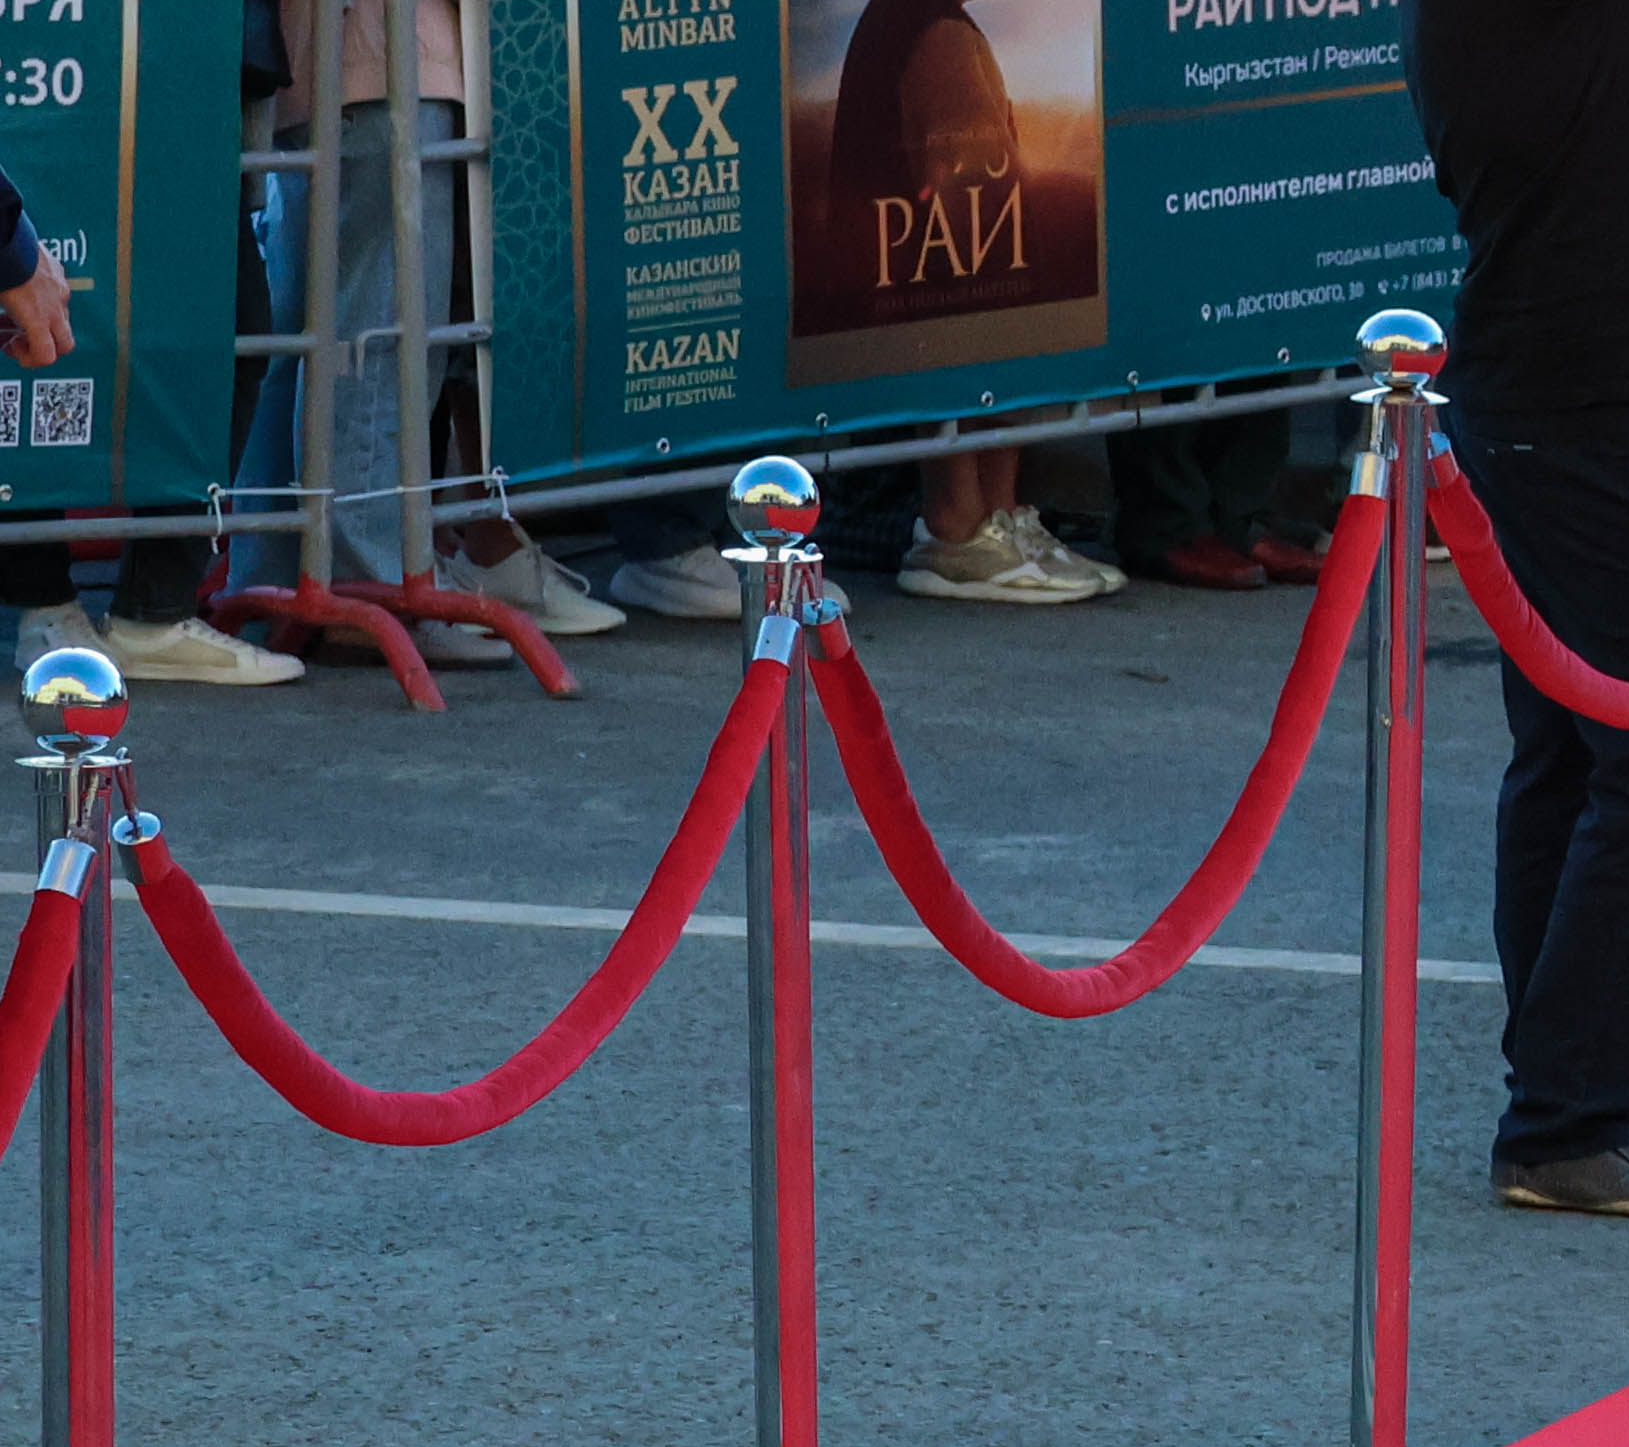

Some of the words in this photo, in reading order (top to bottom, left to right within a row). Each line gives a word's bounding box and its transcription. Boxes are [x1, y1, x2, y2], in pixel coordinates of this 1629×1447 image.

[620, 13, 737, 52] MINBAR
[0, 57, 83, 106] :30
[1184, 54, 1309, 91] Кыргызстан
[623, 159, 740, 205] КАЗАН
[1184, 172, 1343, 212] исполнителем
[1347, 154, 1437, 189] главной
[623, 213, 742, 244] ФЕСТИВАЛЕ
[872, 152, 1030, 289] РАЙ
[626, 249, 741, 287] КАЗАНСКИЙ
[1315, 243, 1383, 268] ПРОДАЖА
[1215, 301, 1234, 323] ул.
[1236, 283, 1346, 318] ДОСТОЕВСКОГО,
[625, 328, 741, 374] KAZAN
[624, 394, 662, 414] FILM
[666, 384, 736, 408] FESTIVAL
[625, 365, 738, 394] INTERNATIONAL
